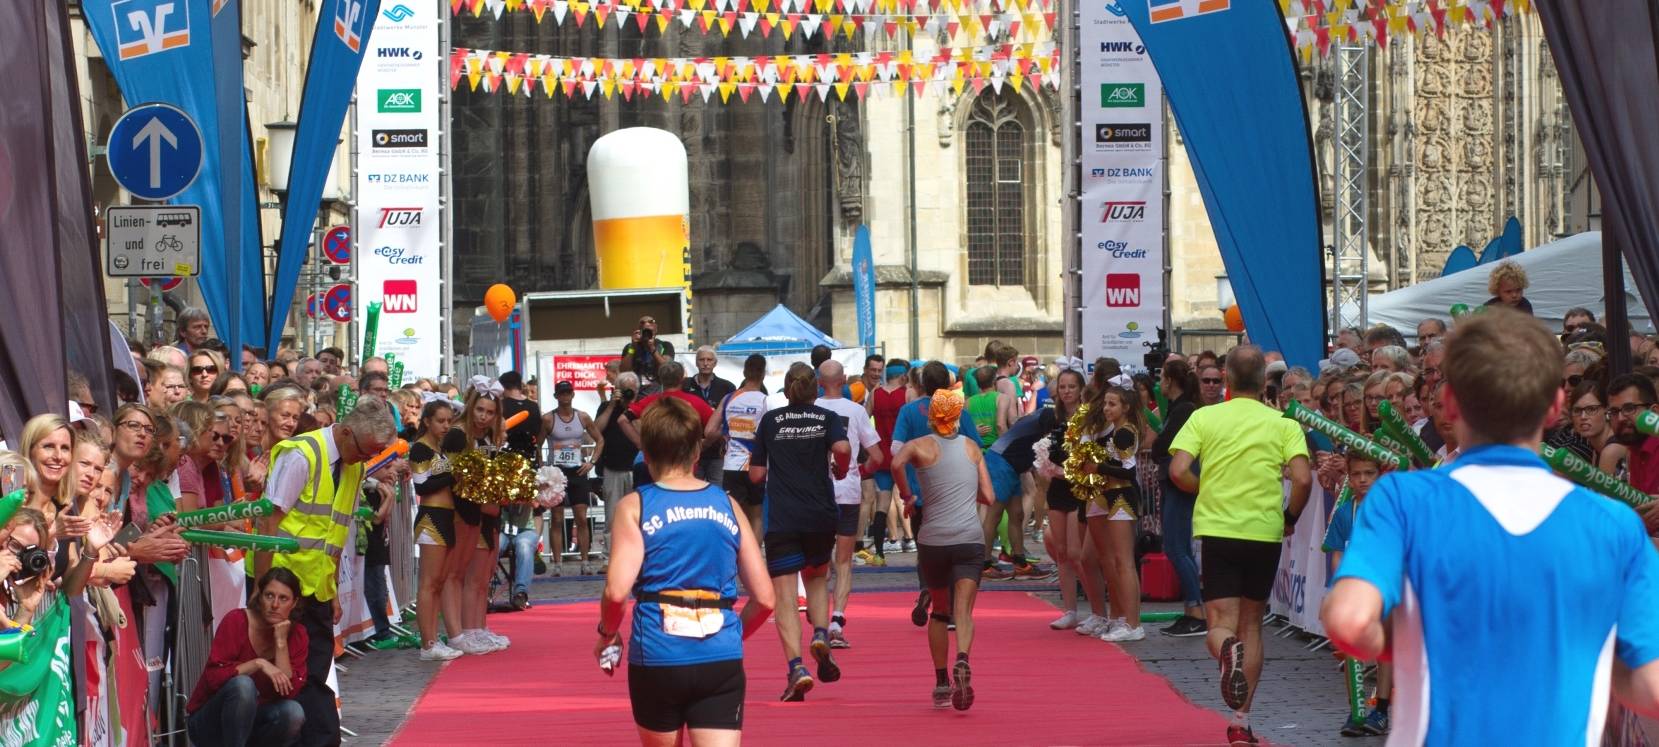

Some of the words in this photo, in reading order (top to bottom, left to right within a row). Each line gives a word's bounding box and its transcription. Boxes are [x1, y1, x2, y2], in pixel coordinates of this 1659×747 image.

[377, 47, 410, 58] HWK
[1101, 42, 1133, 52] HWK
[384, 92, 414, 106] AOK
[1109, 87, 1137, 100] AOK
[390, 132, 424, 143] smart
[1115, 128, 1147, 137] smart
[383, 173, 397, 183] DZ
[399, 173, 430, 183] BANK
[1107, 168, 1120, 177] DZ
[1123, 168, 1153, 177] BANK
[1101, 201, 1147, 223] TUJA
[113, 215, 151, 228] Linien-
[378, 207, 424, 229] TUJA
[125, 237, 144, 250] und
[1112, 248, 1147, 259] Credit
[141, 258, 165, 271] frei
[389, 254, 424, 265] Credit
[1107, 288, 1139, 305] WN
[384, 294, 417, 311] WN
[557, 362, 608, 370] EHRENAMTL
[557, 371, 573, 379] FÜR
[575, 371, 597, 379] DICH.
[574, 380, 600, 388] MÜNS
[775, 414, 784, 423] SC
[779, 426, 817, 434] GREVING
[1295, 406, 1401, 466] www.aok.de
[560, 451, 575, 461] 461
[642, 515, 664, 535] SC
[666, 505, 739, 536] Altenrheine
